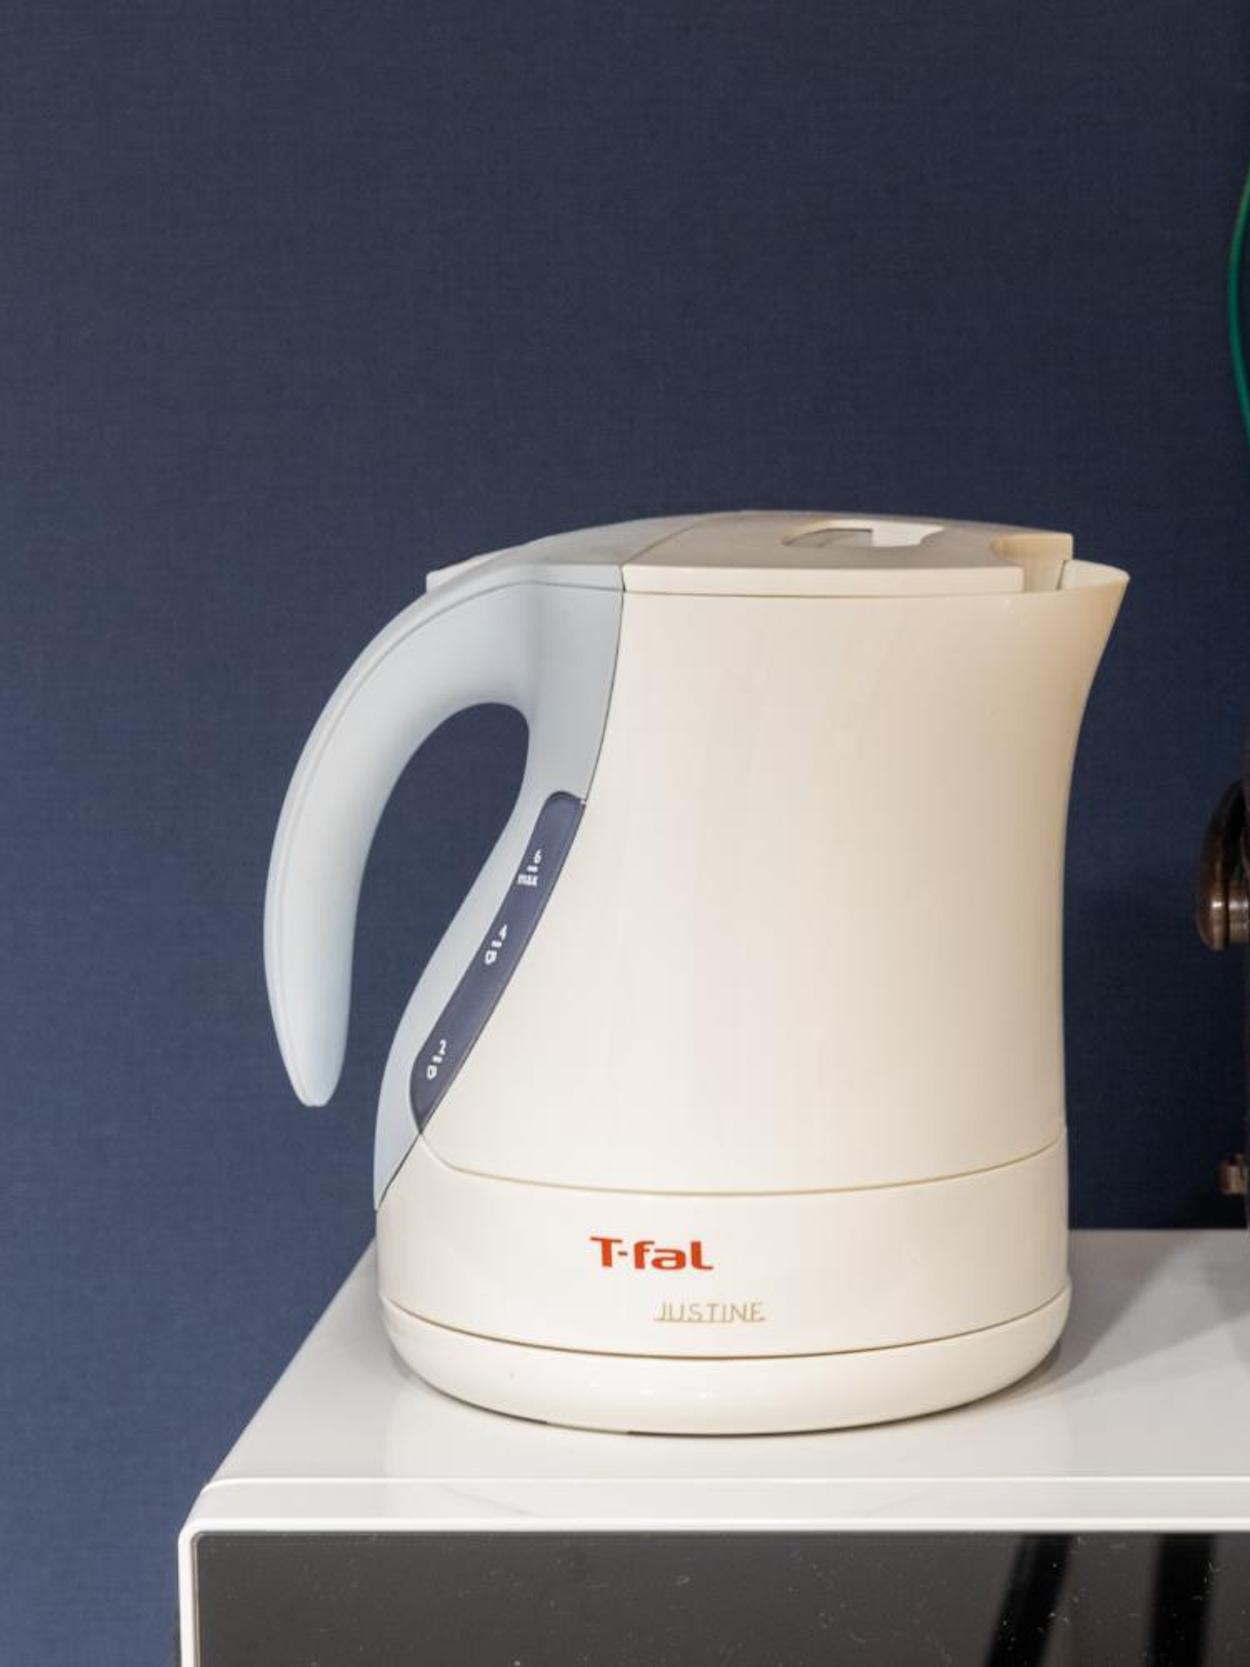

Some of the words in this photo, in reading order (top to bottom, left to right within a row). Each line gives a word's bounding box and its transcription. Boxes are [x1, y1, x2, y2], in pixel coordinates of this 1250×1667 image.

[533, 848, 543, 865] 6
[590, 1235, 714, 1271] T-fal
[654, 1301, 766, 1323] JUSTINE
